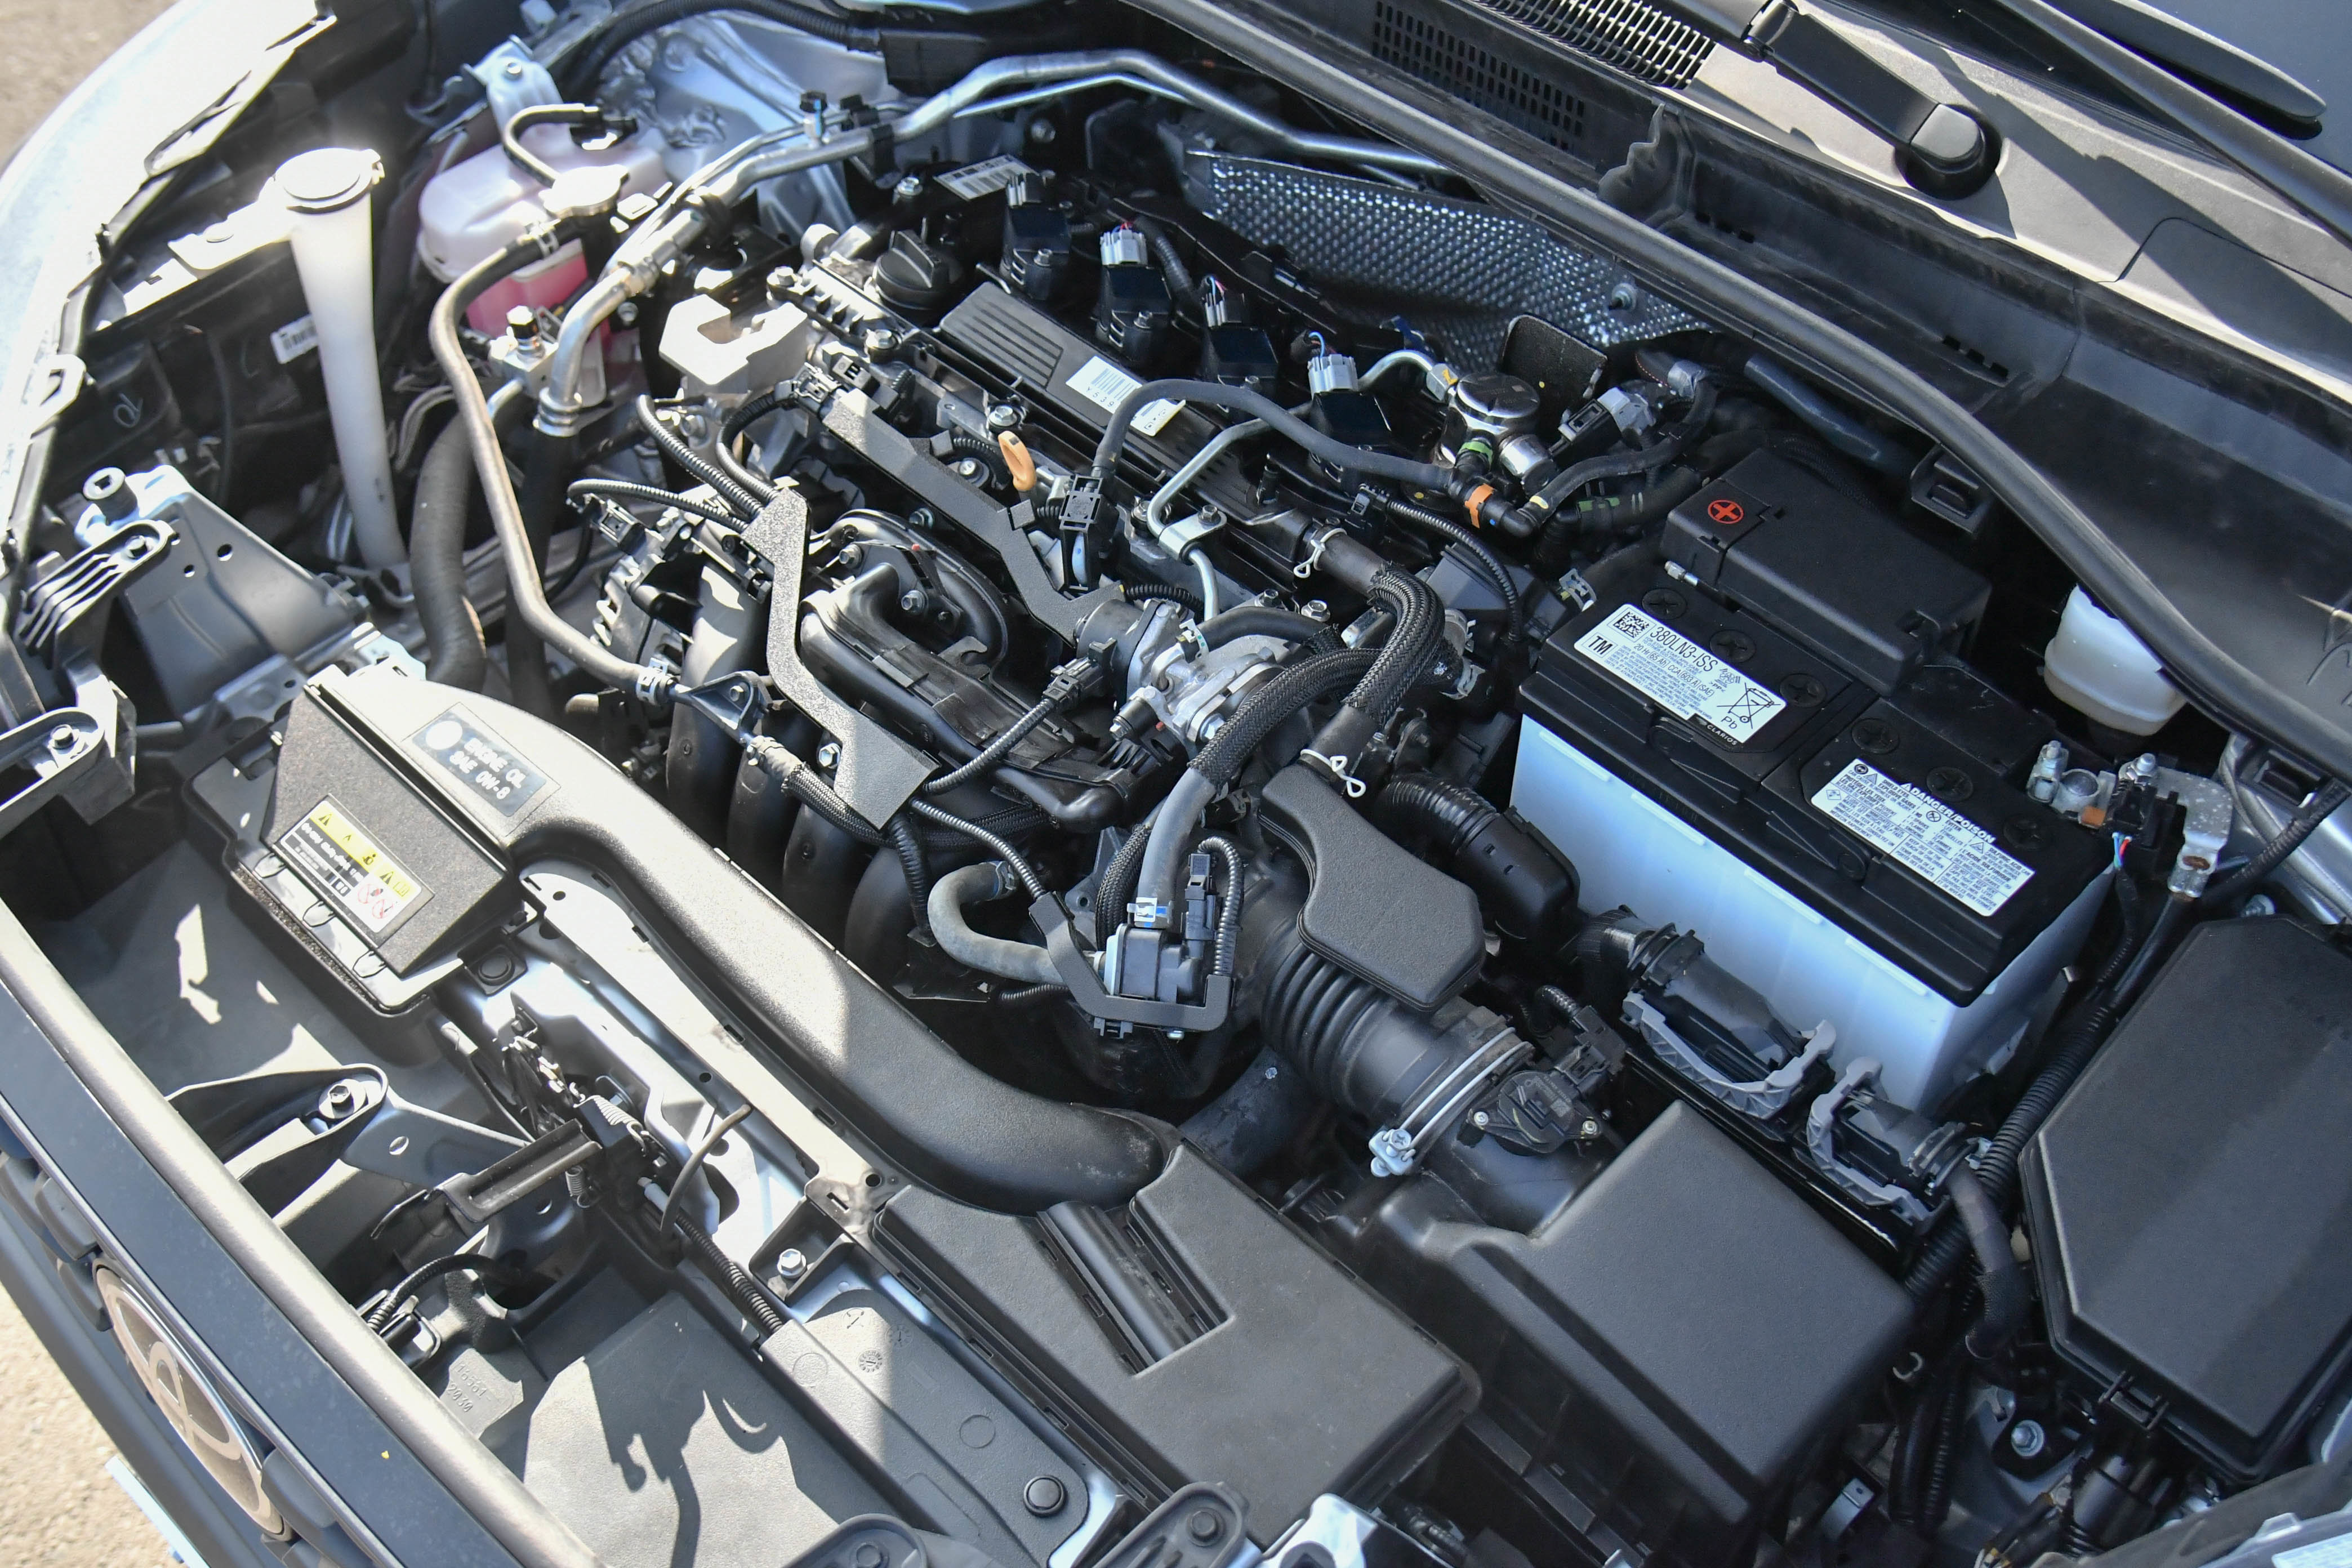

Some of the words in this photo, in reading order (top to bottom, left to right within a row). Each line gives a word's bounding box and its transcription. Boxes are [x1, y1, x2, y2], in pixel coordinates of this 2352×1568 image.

[1588, 635, 1612, 654] TM
[1650, 627, 1717, 671] 380LN3-ISS
[1667, 664, 1681, 675] CCA
[1680, 672, 1694, 682] 603
[1696, 684, 1714, 697] (SAE)
[1721, 715, 1737, 729] Pb
[1707, 724, 1739, 745] CLARIOS
[449, 750, 478, 774] SAE
[464, 737, 508, 773] ENGINE
[505, 768, 526, 789] OIL
[1843, 774, 1865, 790] PROTÉGEZ
[1882, 779, 1897, 790] SHIELD
[1856, 789, 1879, 805] EXPLOSIFS
[1878, 783, 1901, 799] EXPLOSIVE
[1901, 798, 1916, 808] GASES
[1909, 786, 1996, 844] DANGER/POISON
[1962, 849, 1981, 862] L'ACIDE
[1981, 861, 2011, 881] SULFURIQUE
[1988, 847, 2010, 862] SULFURIC
[2010, 861, 2022, 870] ACID
